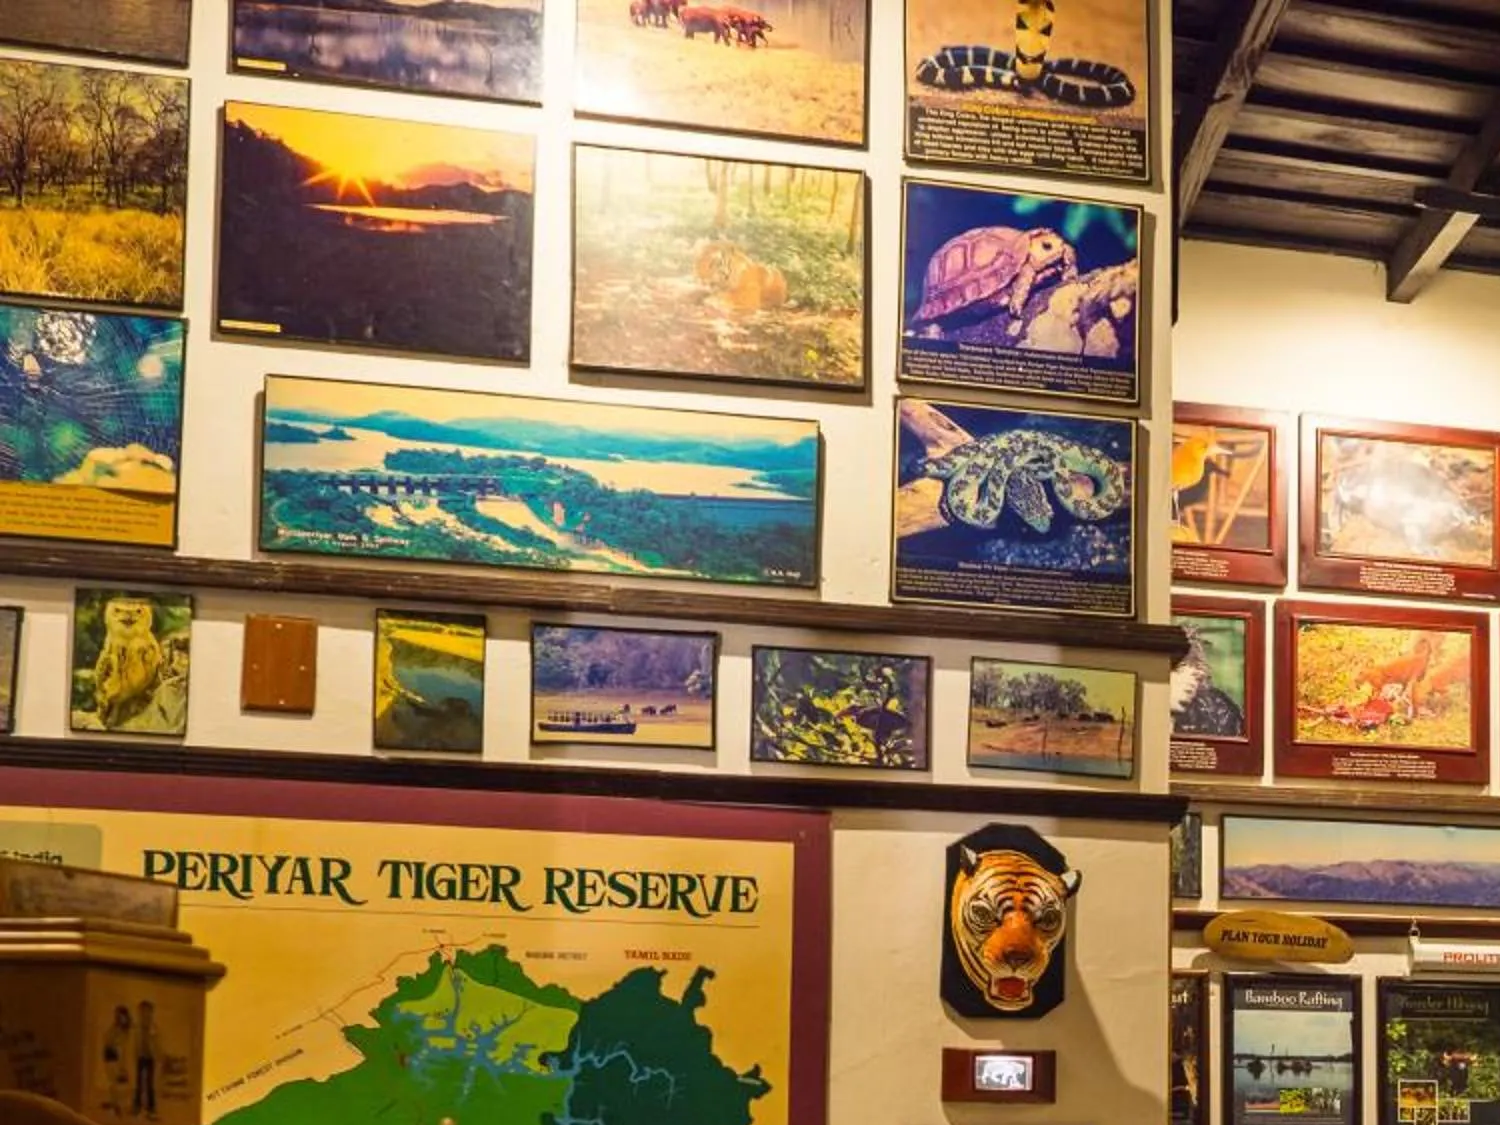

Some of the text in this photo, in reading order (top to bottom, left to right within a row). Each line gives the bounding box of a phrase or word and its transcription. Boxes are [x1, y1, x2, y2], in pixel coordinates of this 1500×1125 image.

[143, 850, 759, 918] PERIYAR TIGER RESERVE
[1220, 929, 1329, 949] PLAN YOUR HOLIDAY
[1245, 989, 1343, 1009] Bamboo Rafting
